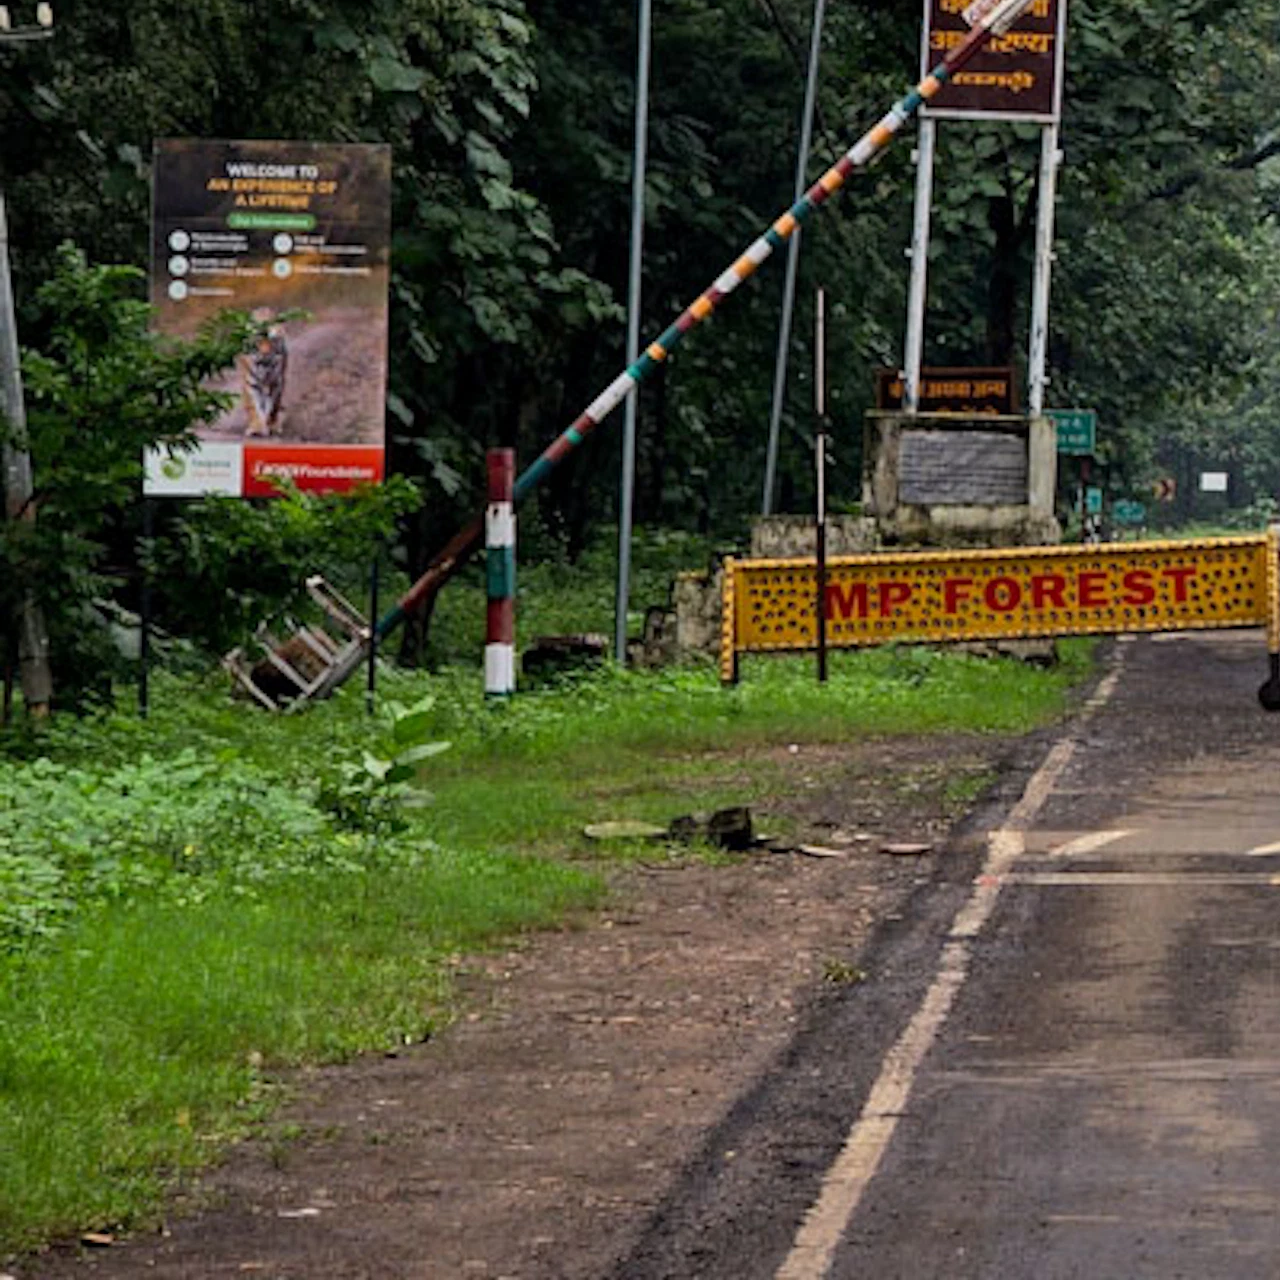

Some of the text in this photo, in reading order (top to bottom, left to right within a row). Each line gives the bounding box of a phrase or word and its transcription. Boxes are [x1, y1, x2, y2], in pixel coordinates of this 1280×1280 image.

[226, 163, 318, 178] WELCOME TO
[207, 179, 337, 193] AN EXPERIENCE OF
[249, 195, 308, 208] LIFETIME
[942, 567, 1198, 615] FOREST
